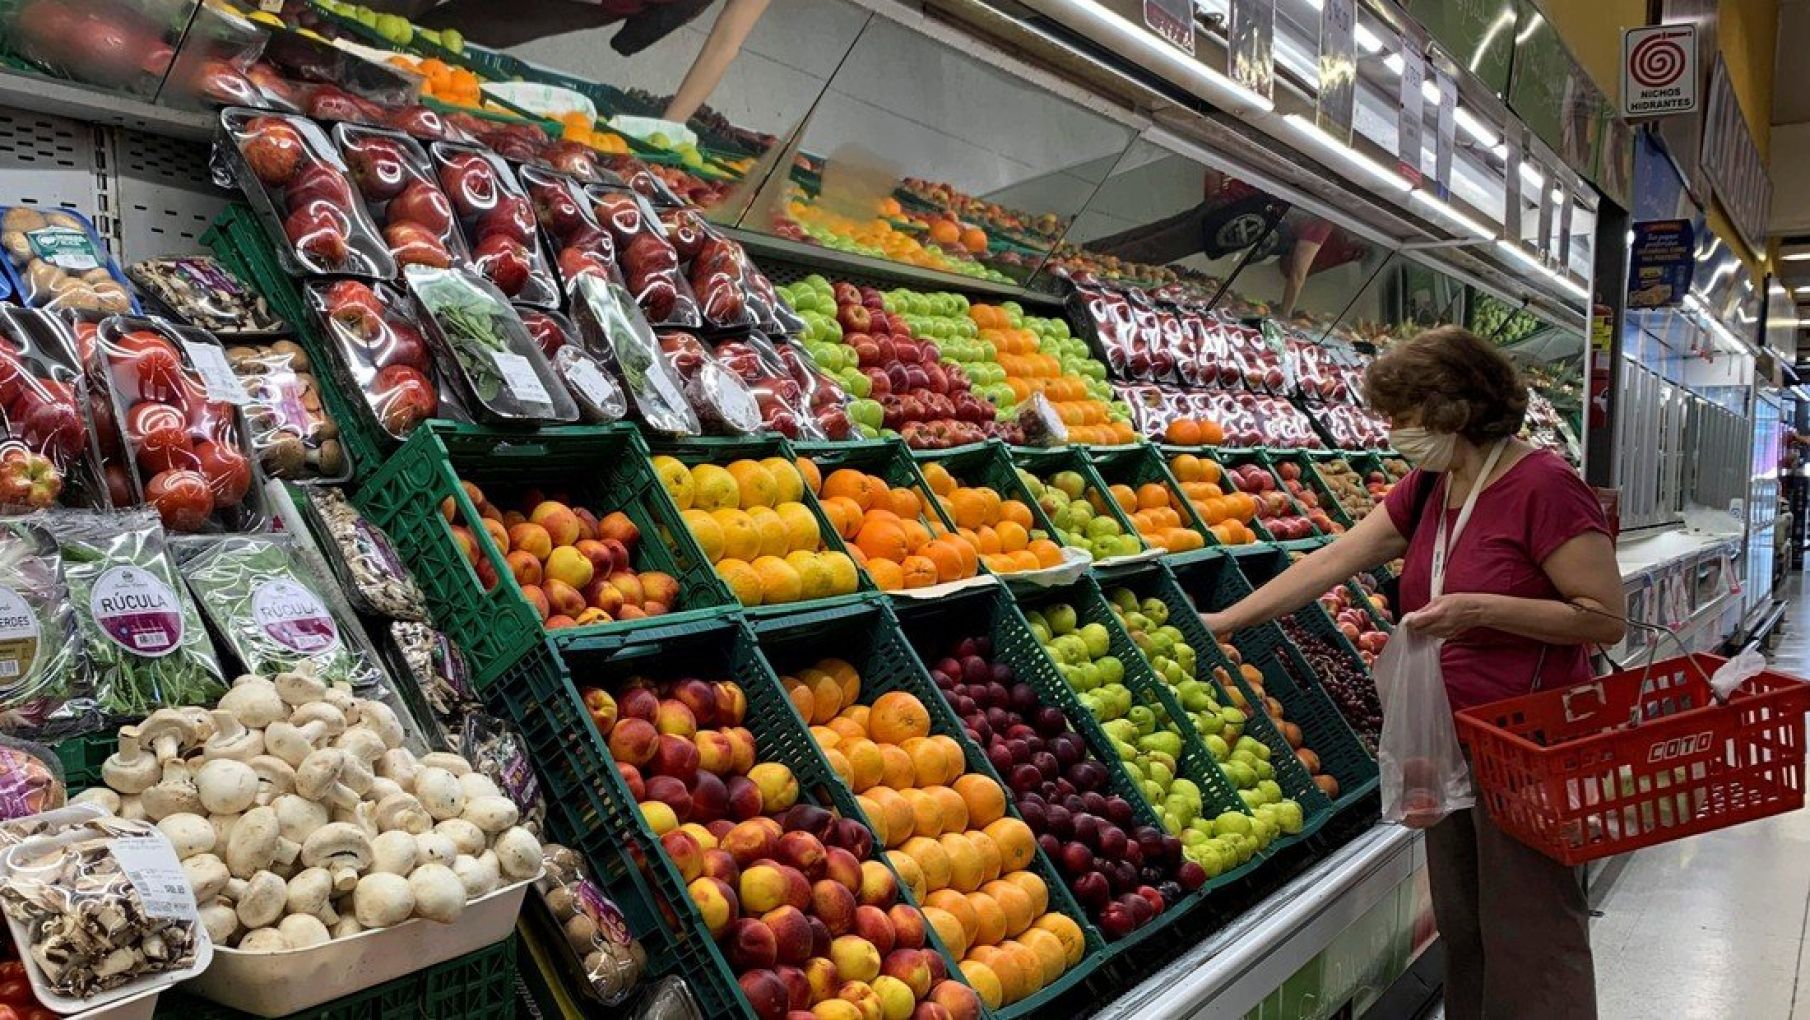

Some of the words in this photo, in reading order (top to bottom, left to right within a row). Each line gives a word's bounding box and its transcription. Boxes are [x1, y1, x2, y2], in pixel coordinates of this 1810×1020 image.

[1641, 87, 1681, 98] NICHOS
[1631, 98, 1691, 110] HIDRANTES
[101, 591, 168, 612] RÚCULA
[260, 601, 320, 620] RÚCULA
[1648, 731, 1713, 763] COTO
